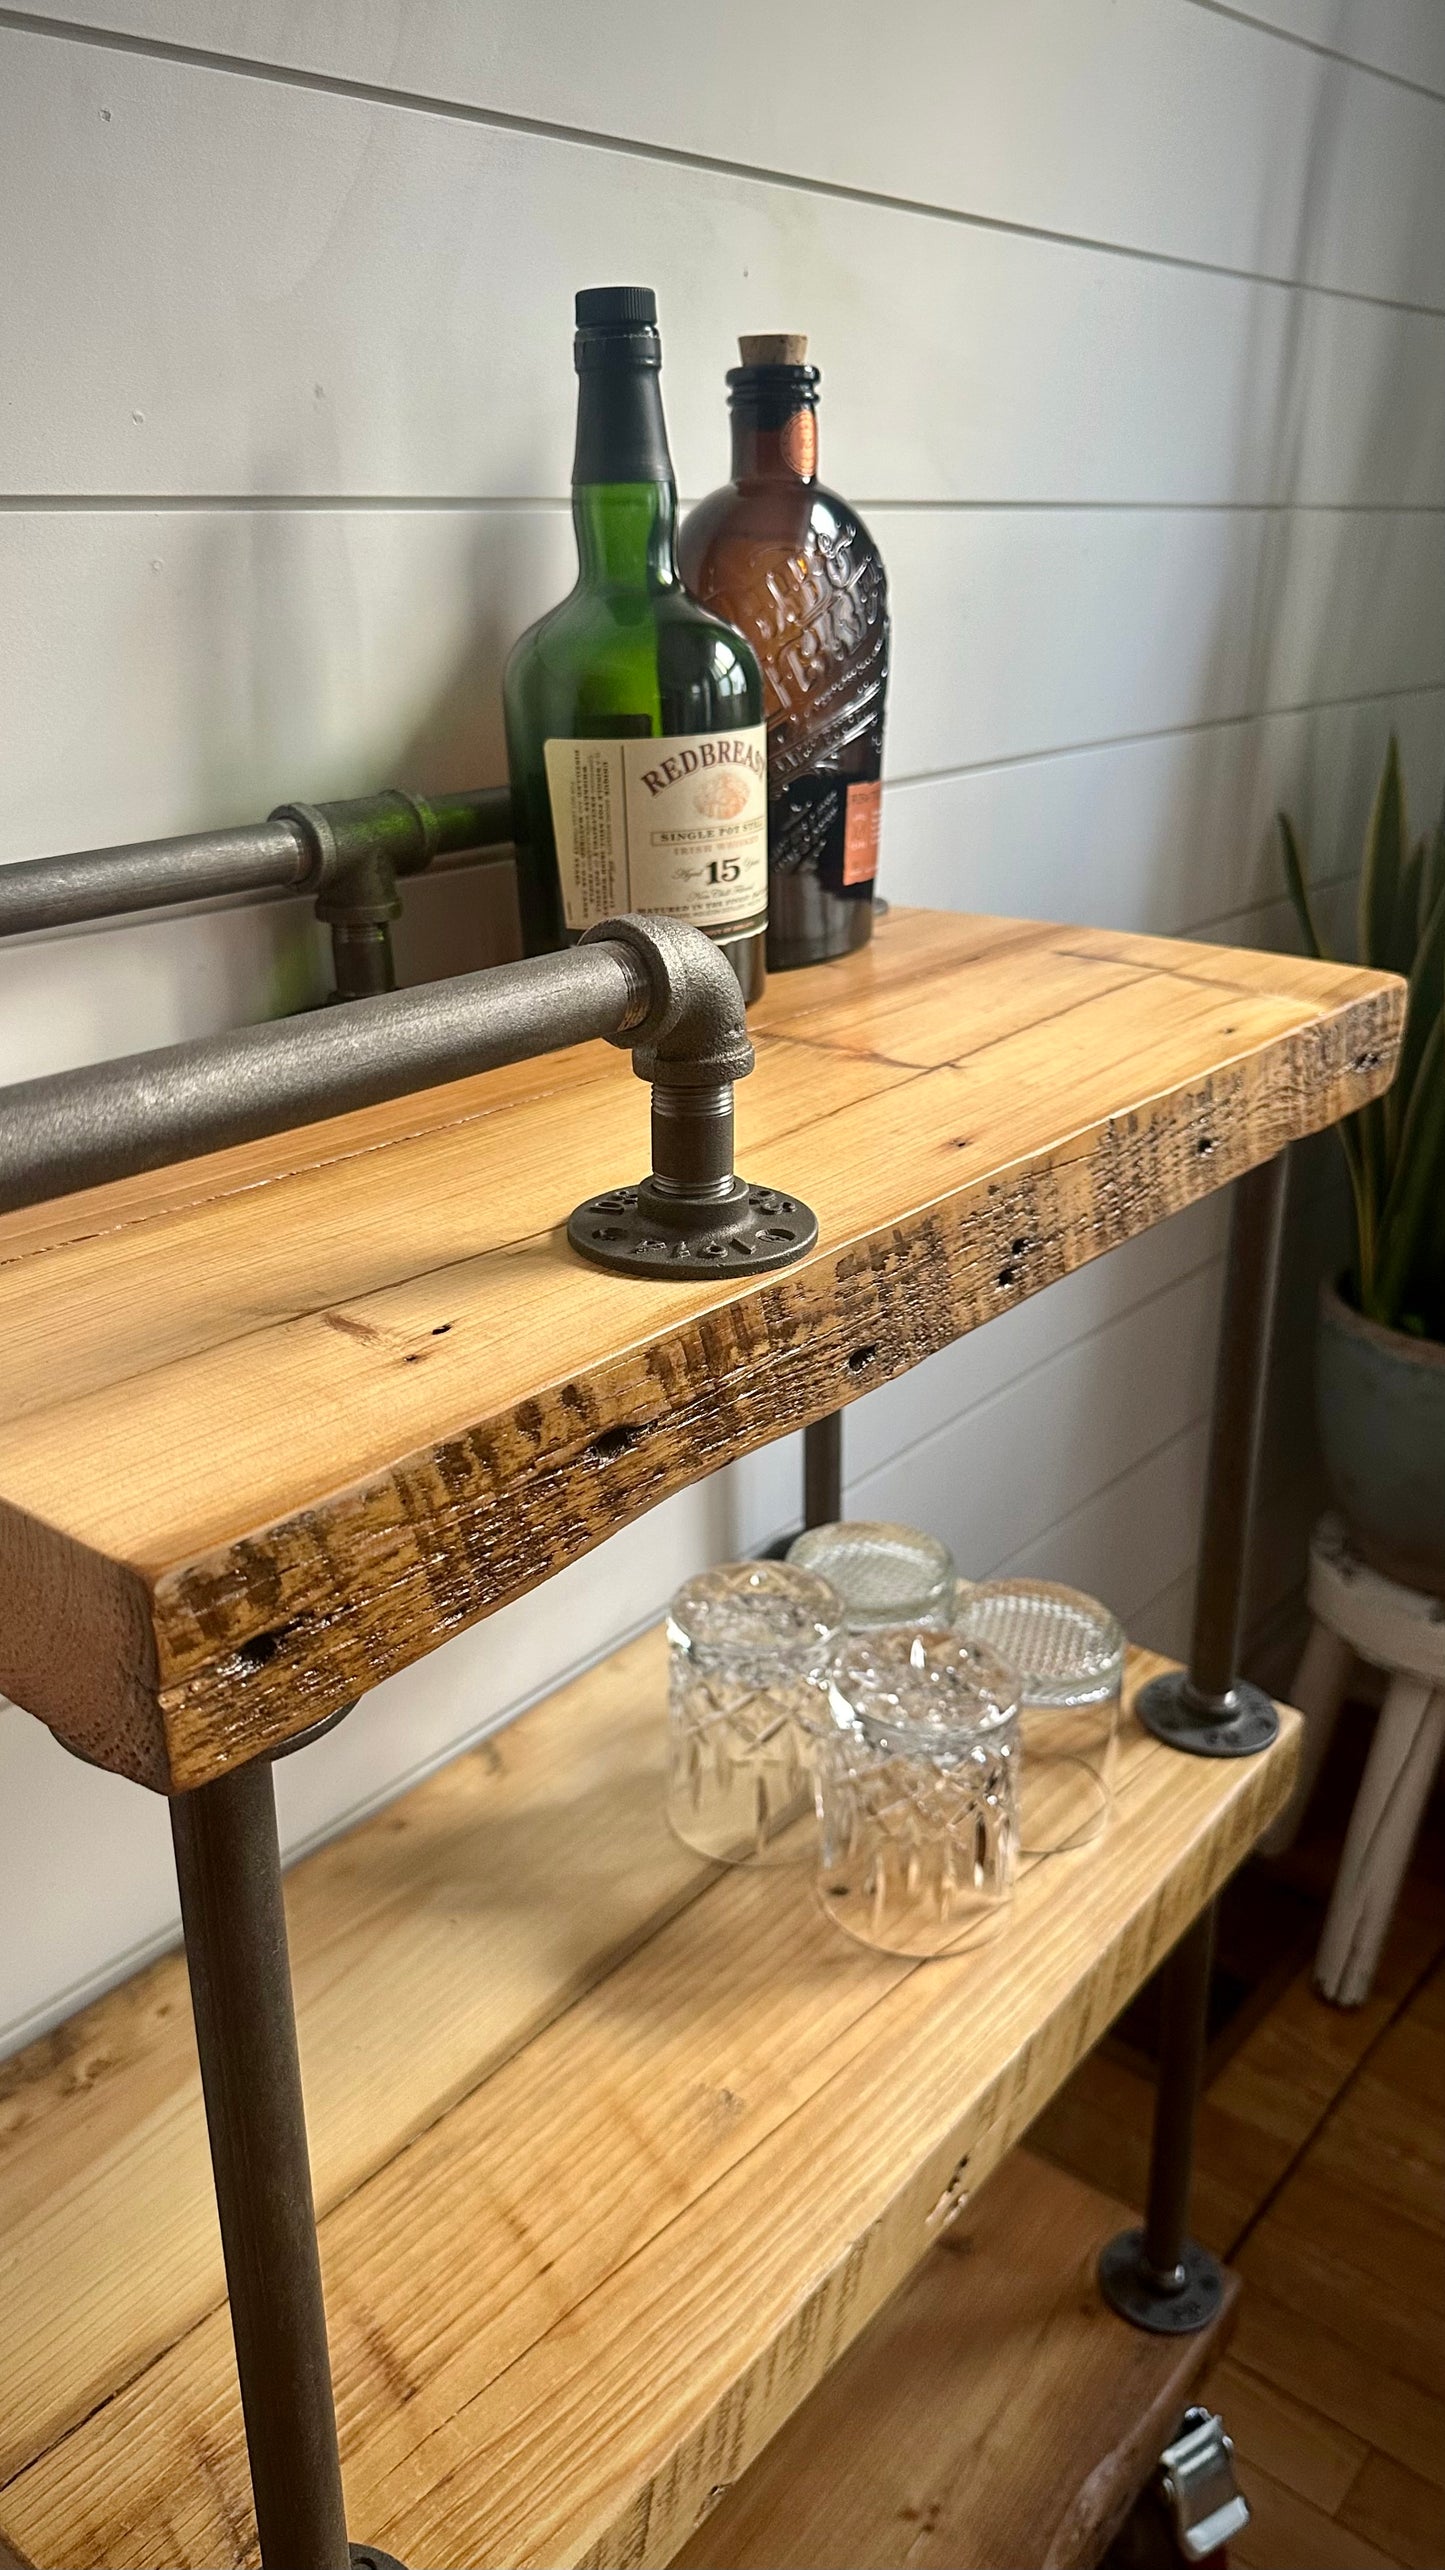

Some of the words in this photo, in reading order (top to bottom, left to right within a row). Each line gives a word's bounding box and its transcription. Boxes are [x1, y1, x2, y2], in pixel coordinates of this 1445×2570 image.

[641, 740, 765, 797] REDBREAS
[660, 829, 716, 843] SINGLE
[718, 824, 741, 837] POT
[706, 857, 741, 886] 15
